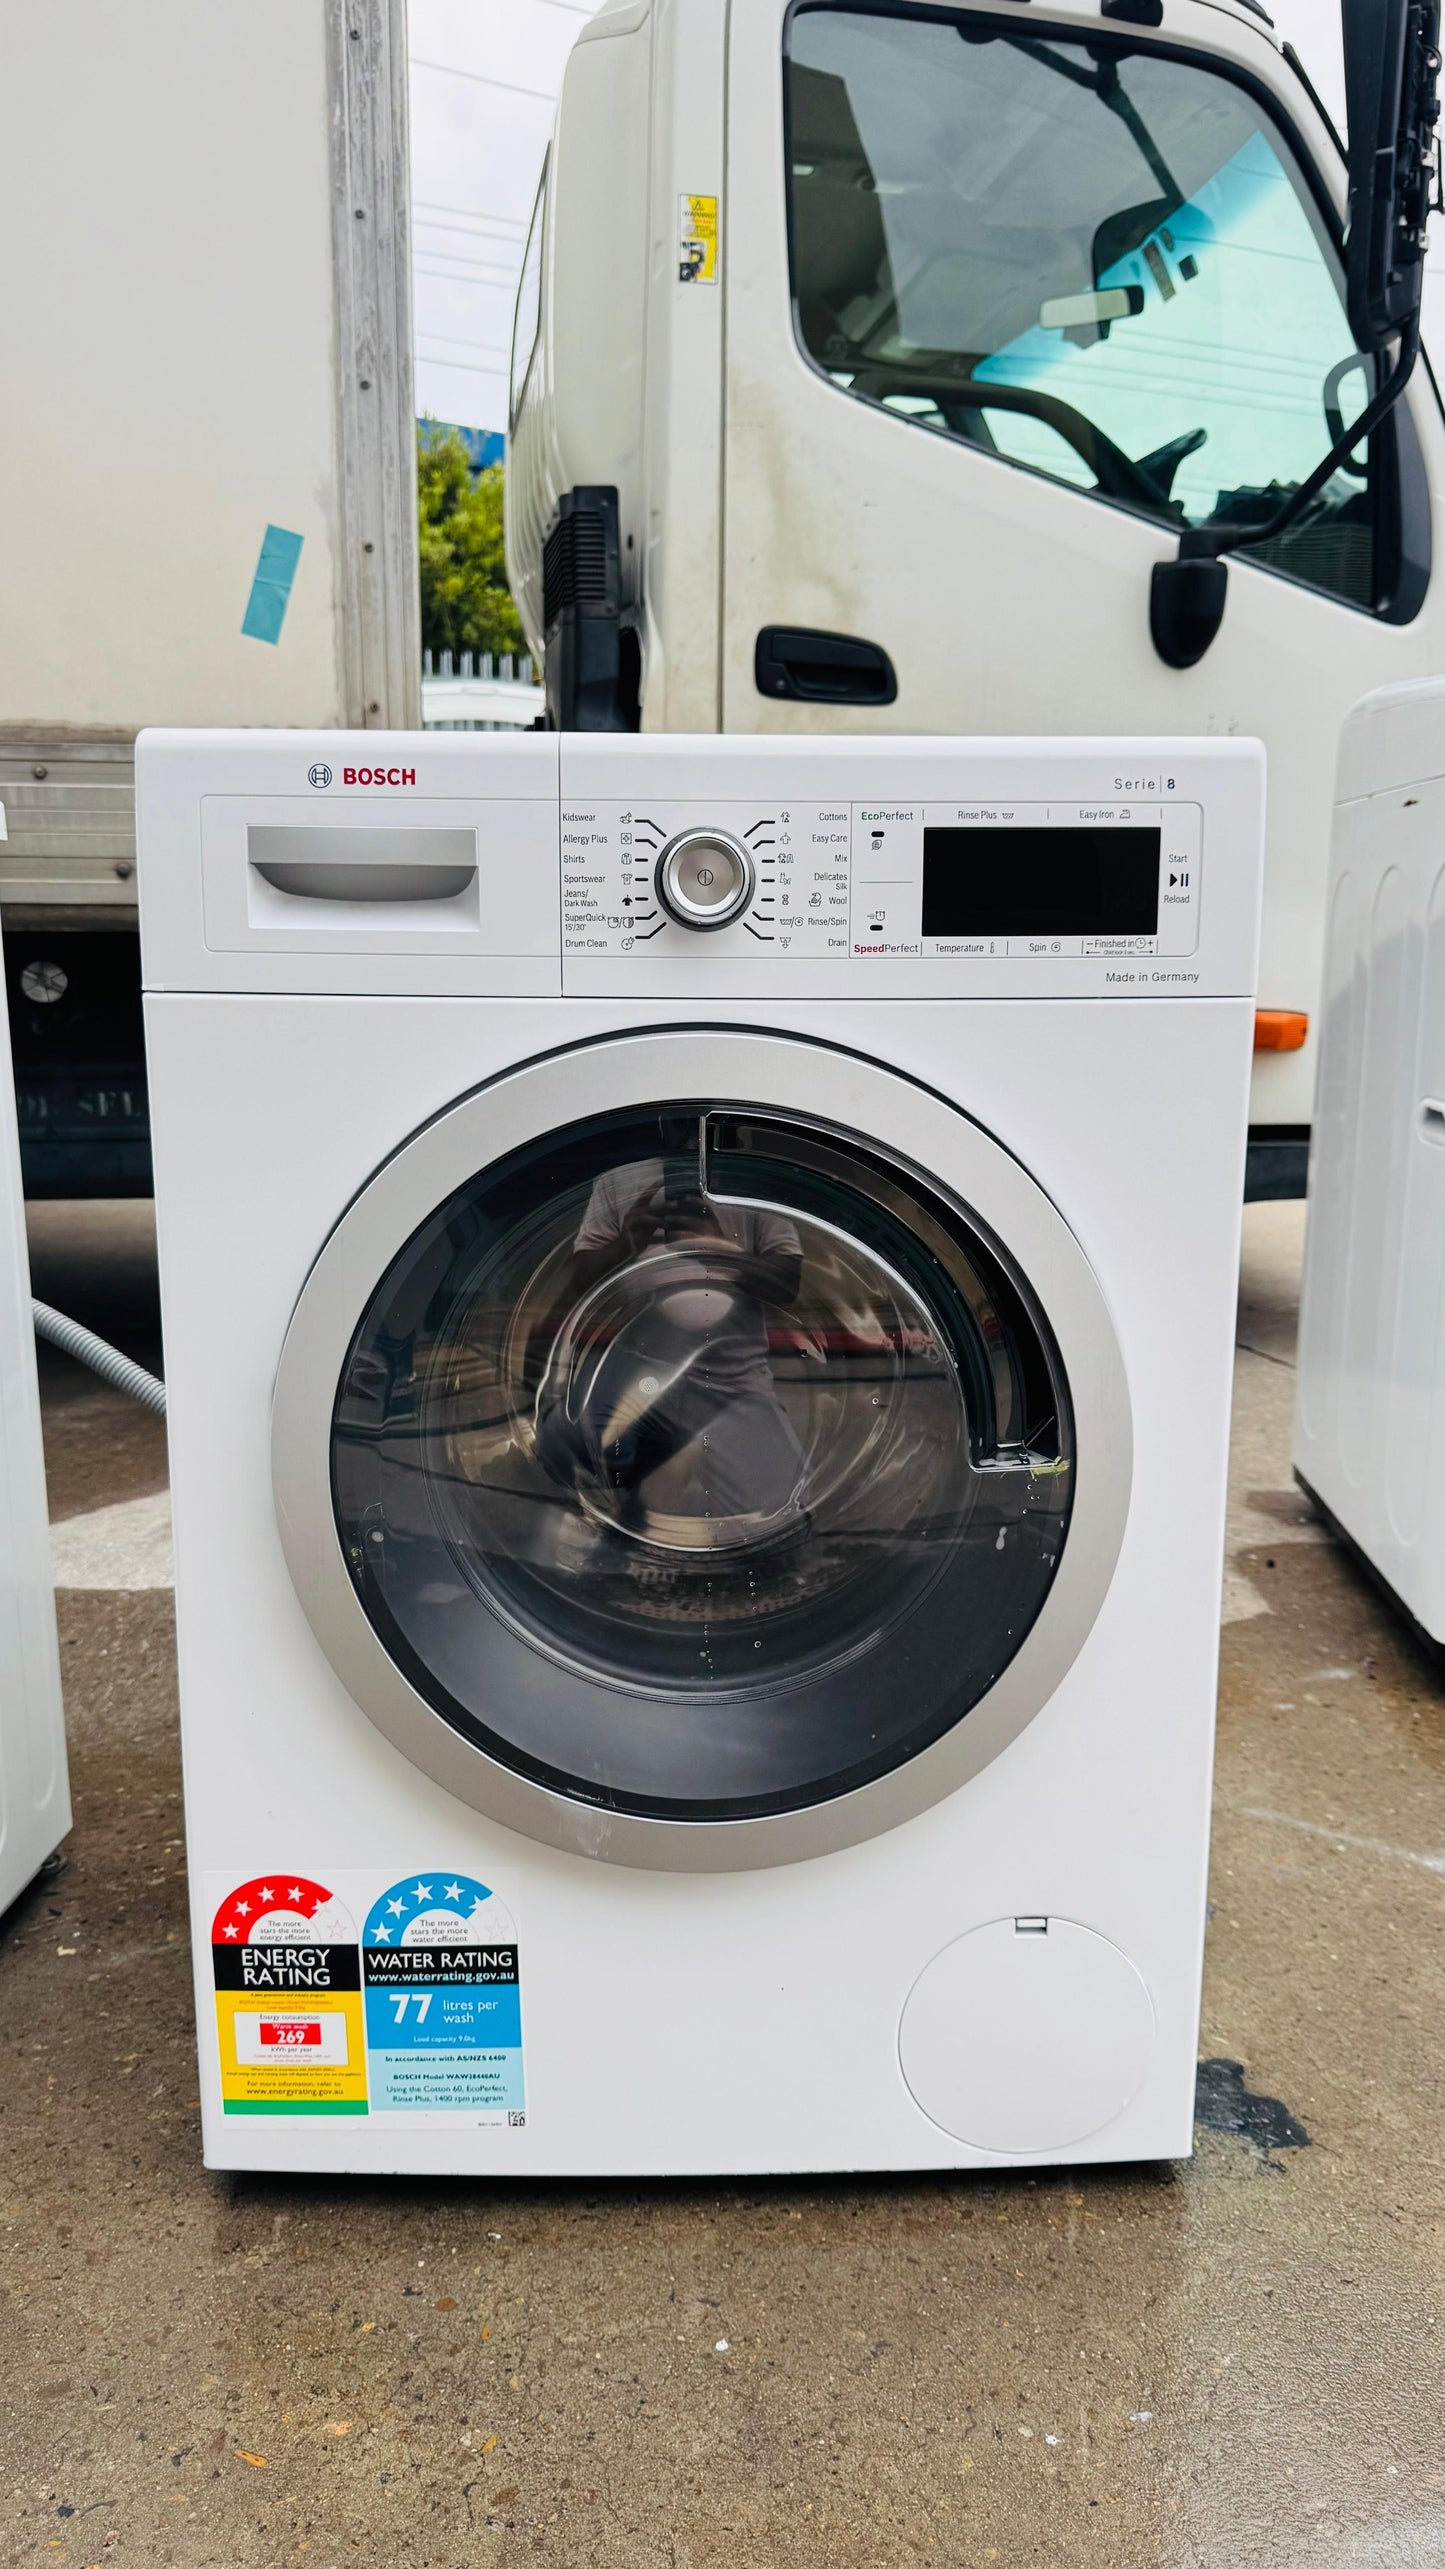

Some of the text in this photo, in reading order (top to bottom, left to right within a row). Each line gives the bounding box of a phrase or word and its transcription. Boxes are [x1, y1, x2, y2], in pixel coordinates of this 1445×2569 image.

[343, 768, 416, 786] BOSCH
[1114, 778, 1176, 790] Serie 8
[562, 813, 596, 821] Kidswear
[819, 813, 848, 821] Cottons
[861, 812, 914, 820] EcoPerfect
[958, 809, 997, 820] Rinse Plus
[1079, 809, 1115, 821] Easy Iron
[563, 834, 608, 845] Allergy Plus
[812, 834, 848, 844] Easy Care
[563, 855, 585, 863] Shirts
[1168, 853, 1188, 863] Start
[564, 875, 606, 884] Sportswear
[814, 873, 848, 881] Delicates
[564, 889, 589, 898] Jeans/
[829, 896, 848, 904] Wool
[1163, 894, 1190, 905] Reload
[565, 914, 606, 922] SuperQuick
[808, 917, 847, 926] Rinse/Spin
[566, 940, 586, 948] Drum
[828, 938, 847, 947] Drain
[1029, 942, 1047, 953] Spin
[1094, 939, 1134, 948] Finished in
[854, 944, 918, 954] SpeedPerfect
[935, 942, 984, 955] Temperature
[1106, 972, 1199, 984] Made in Germany
[420, 1919, 435, 1927] The
[241, 1948, 330, 1966] ENERGY
[368, 1952, 513, 1969] WATER RATING
[243, 1968, 331, 1986] RATING
[368, 1971, 514, 1983] www.waterrating.gov.au
[389, 1993, 433, 2024] 77
[443, 2000, 498, 2013] litres per
[443, 2013, 474, 2023] wash
[277, 2030, 305, 2044] 269
[247, 2088, 344, 2096] www.energyrating.gov.au
[386, 2086, 407, 2094] Using
[466, 2085, 508, 2093] EcoPerfect,
[455, 2096, 470, 2104] rpm
[472, 2096, 503, 2104] program
